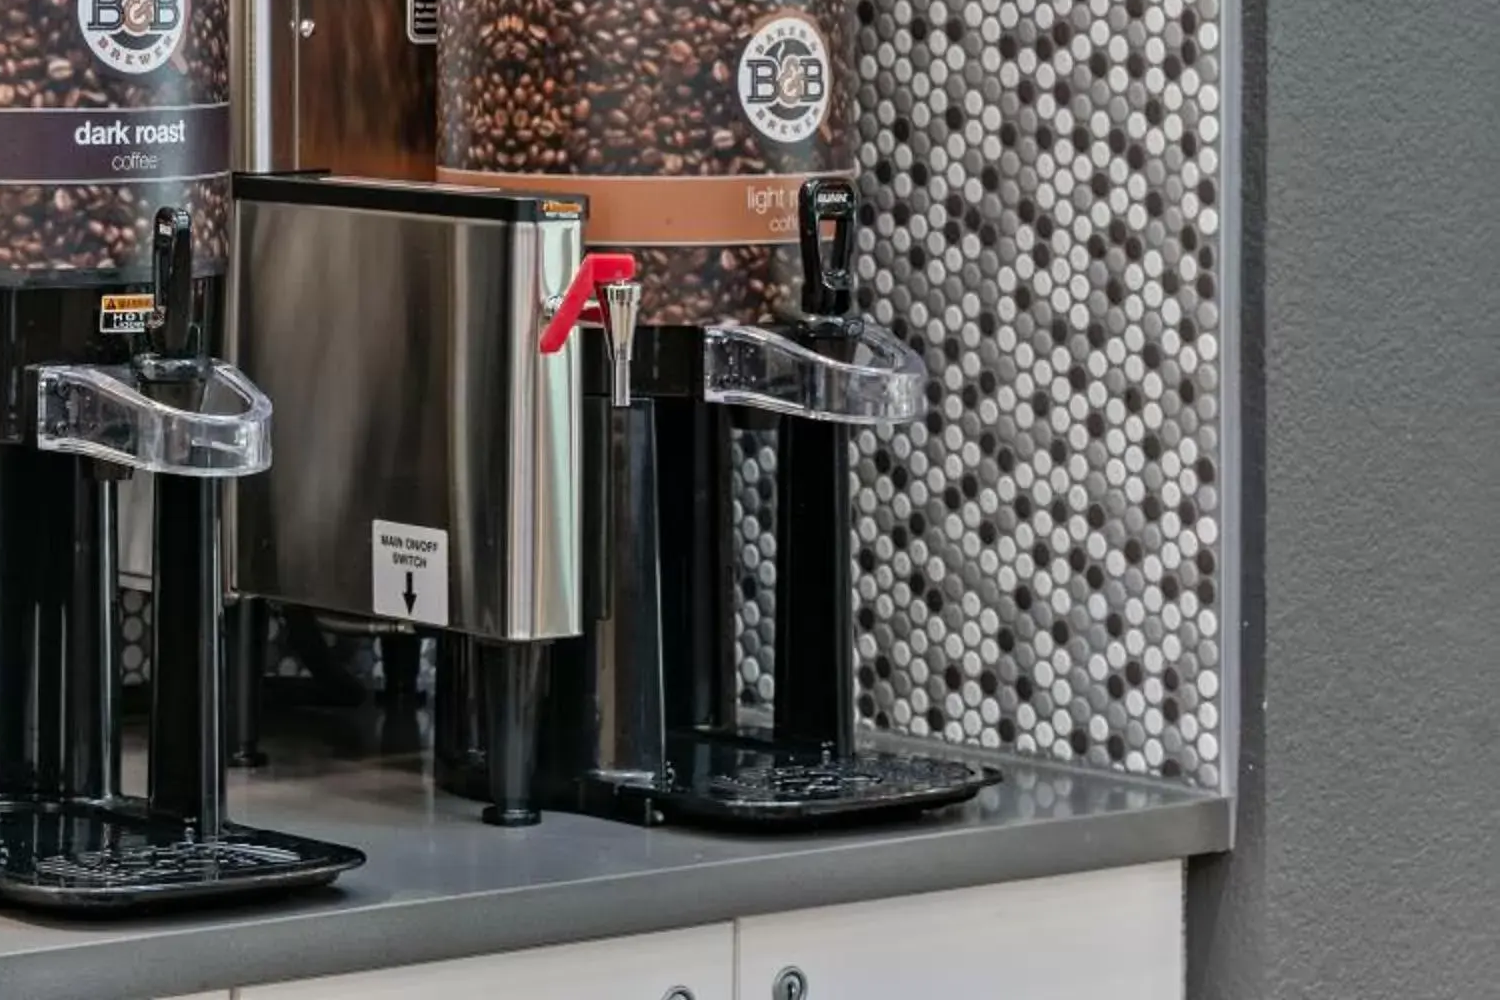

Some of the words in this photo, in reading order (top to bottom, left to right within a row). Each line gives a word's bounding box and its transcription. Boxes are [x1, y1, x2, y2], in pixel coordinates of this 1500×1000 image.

[746, 55, 824, 106] B&B
[75, 119, 131, 145] dark
[135, 119, 186, 143] roast
[112, 152, 159, 171] coffee
[747, 185, 785, 215] light
[113, 312, 144, 321] HOT
[380, 535, 403, 549] MAIN
[405, 538, 438, 552] ON/OFF
[392, 552, 427, 568] SWITCH
